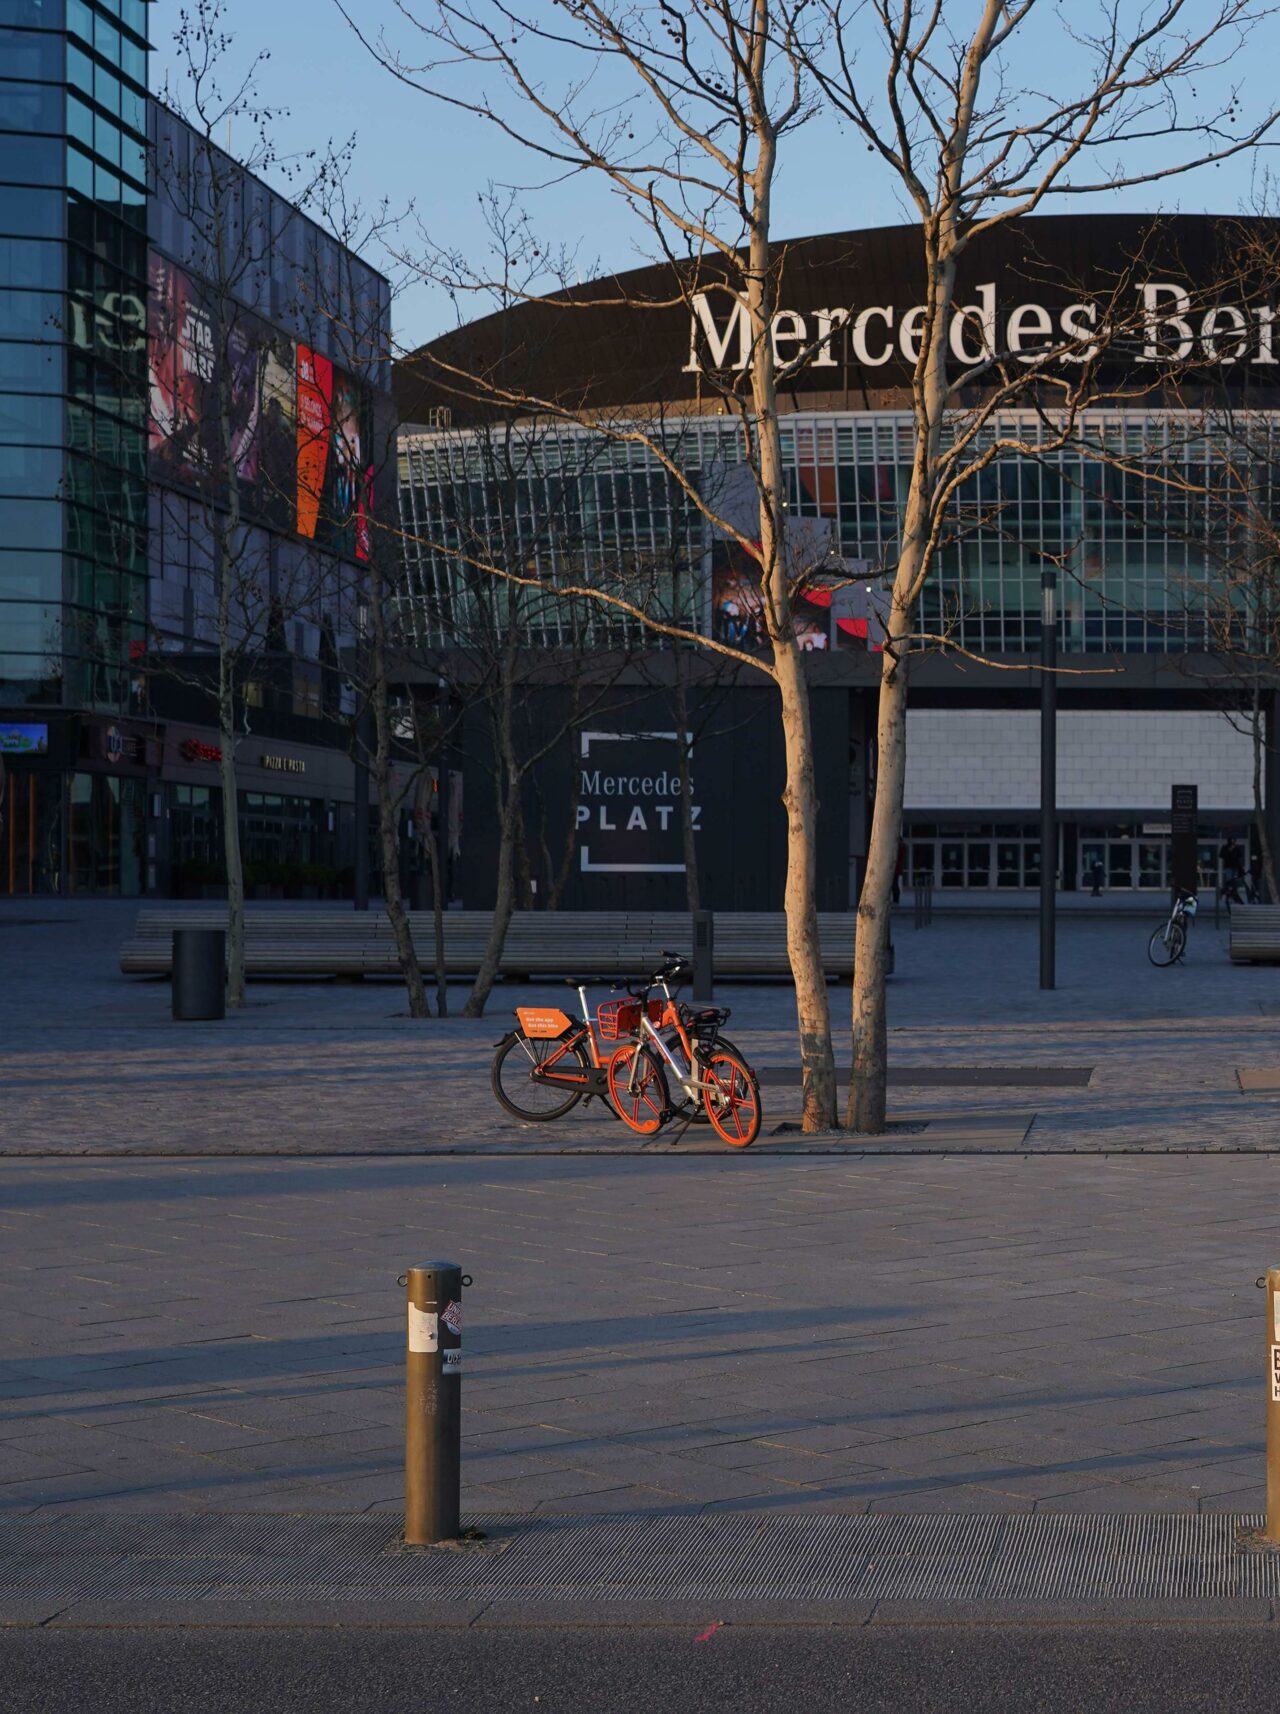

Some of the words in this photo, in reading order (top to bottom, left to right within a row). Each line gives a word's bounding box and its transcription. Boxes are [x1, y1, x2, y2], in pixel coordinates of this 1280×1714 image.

[182, 314, 213, 352] STAR
[182, 350, 215, 383] WARS
[580, 770, 695, 796] Mercedes
[575, 805, 702, 831] PLATZ
